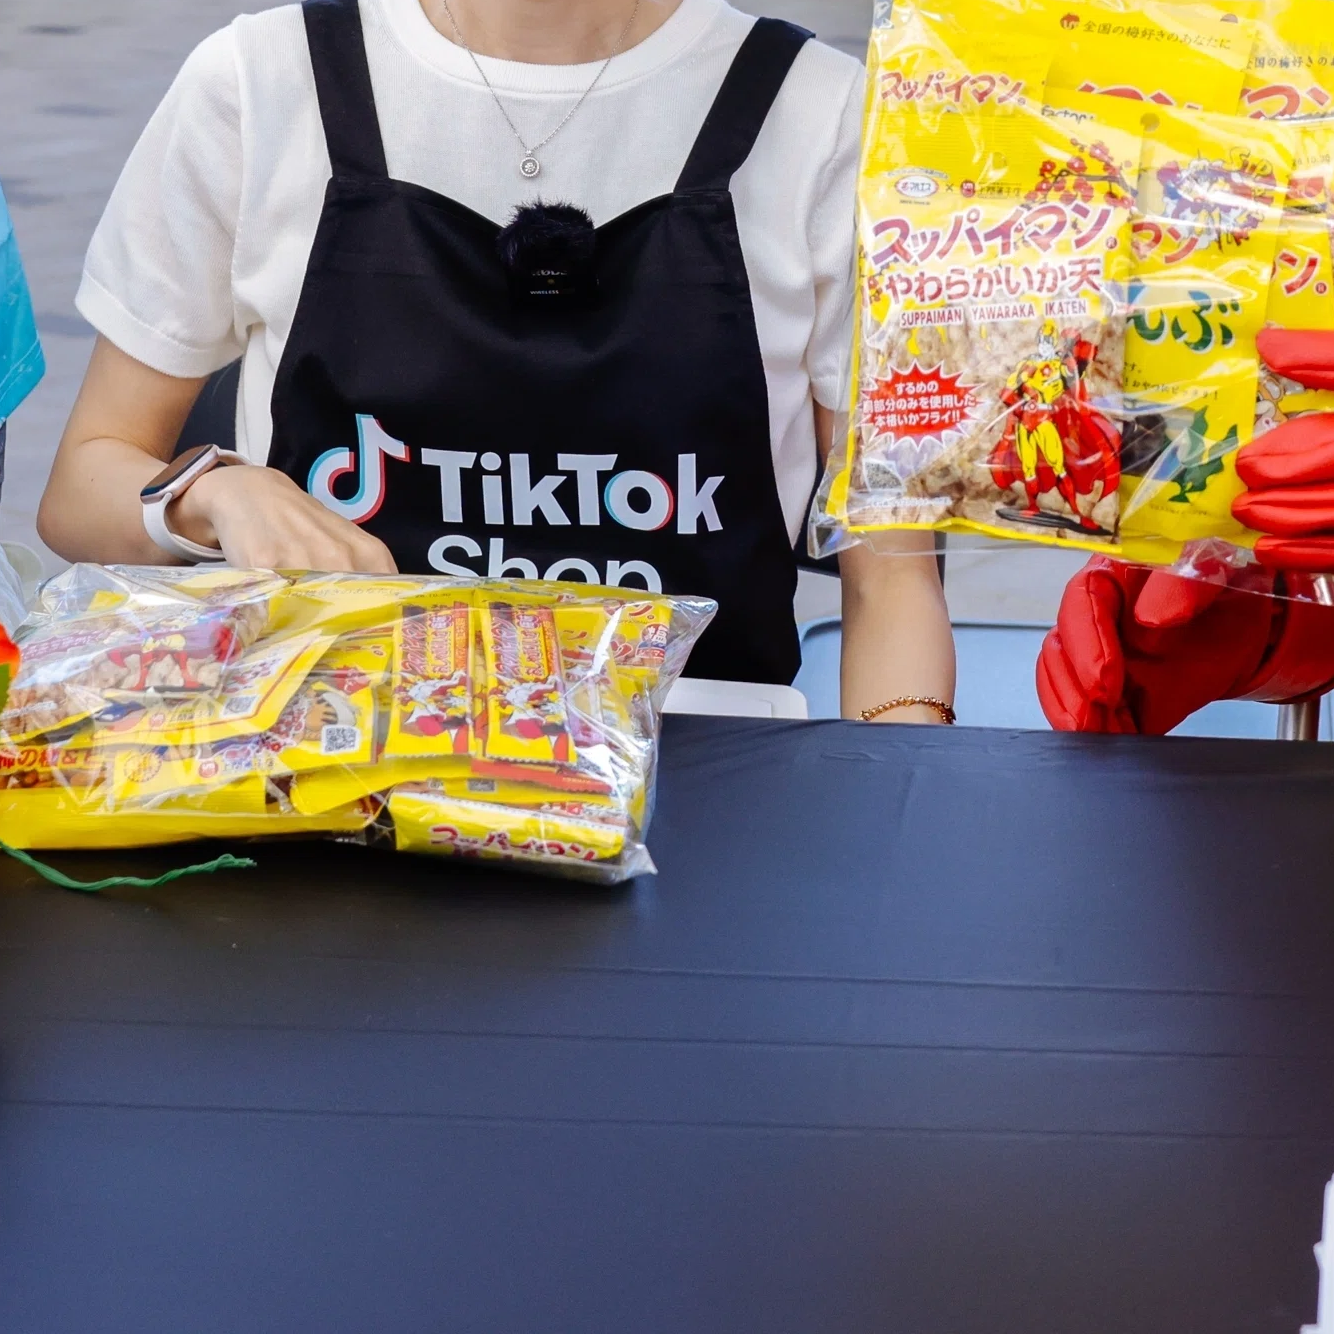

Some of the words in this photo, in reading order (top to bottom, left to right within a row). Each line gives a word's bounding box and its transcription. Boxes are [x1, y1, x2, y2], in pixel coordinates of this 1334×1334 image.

[879, 70, 1024, 104] スッパイマン
[871, 202, 1113, 266] スッパイマン
[886, 257, 1103, 305] やわらかいか天
[901, 307, 963, 328] SUPPAIMAN
[972, 302, 1036, 322] YAWARAKA
[1044, 300, 1088, 317] IKATEN
[895, 380, 940, 395] するめの
[421, 447, 725, 535] TikTok
